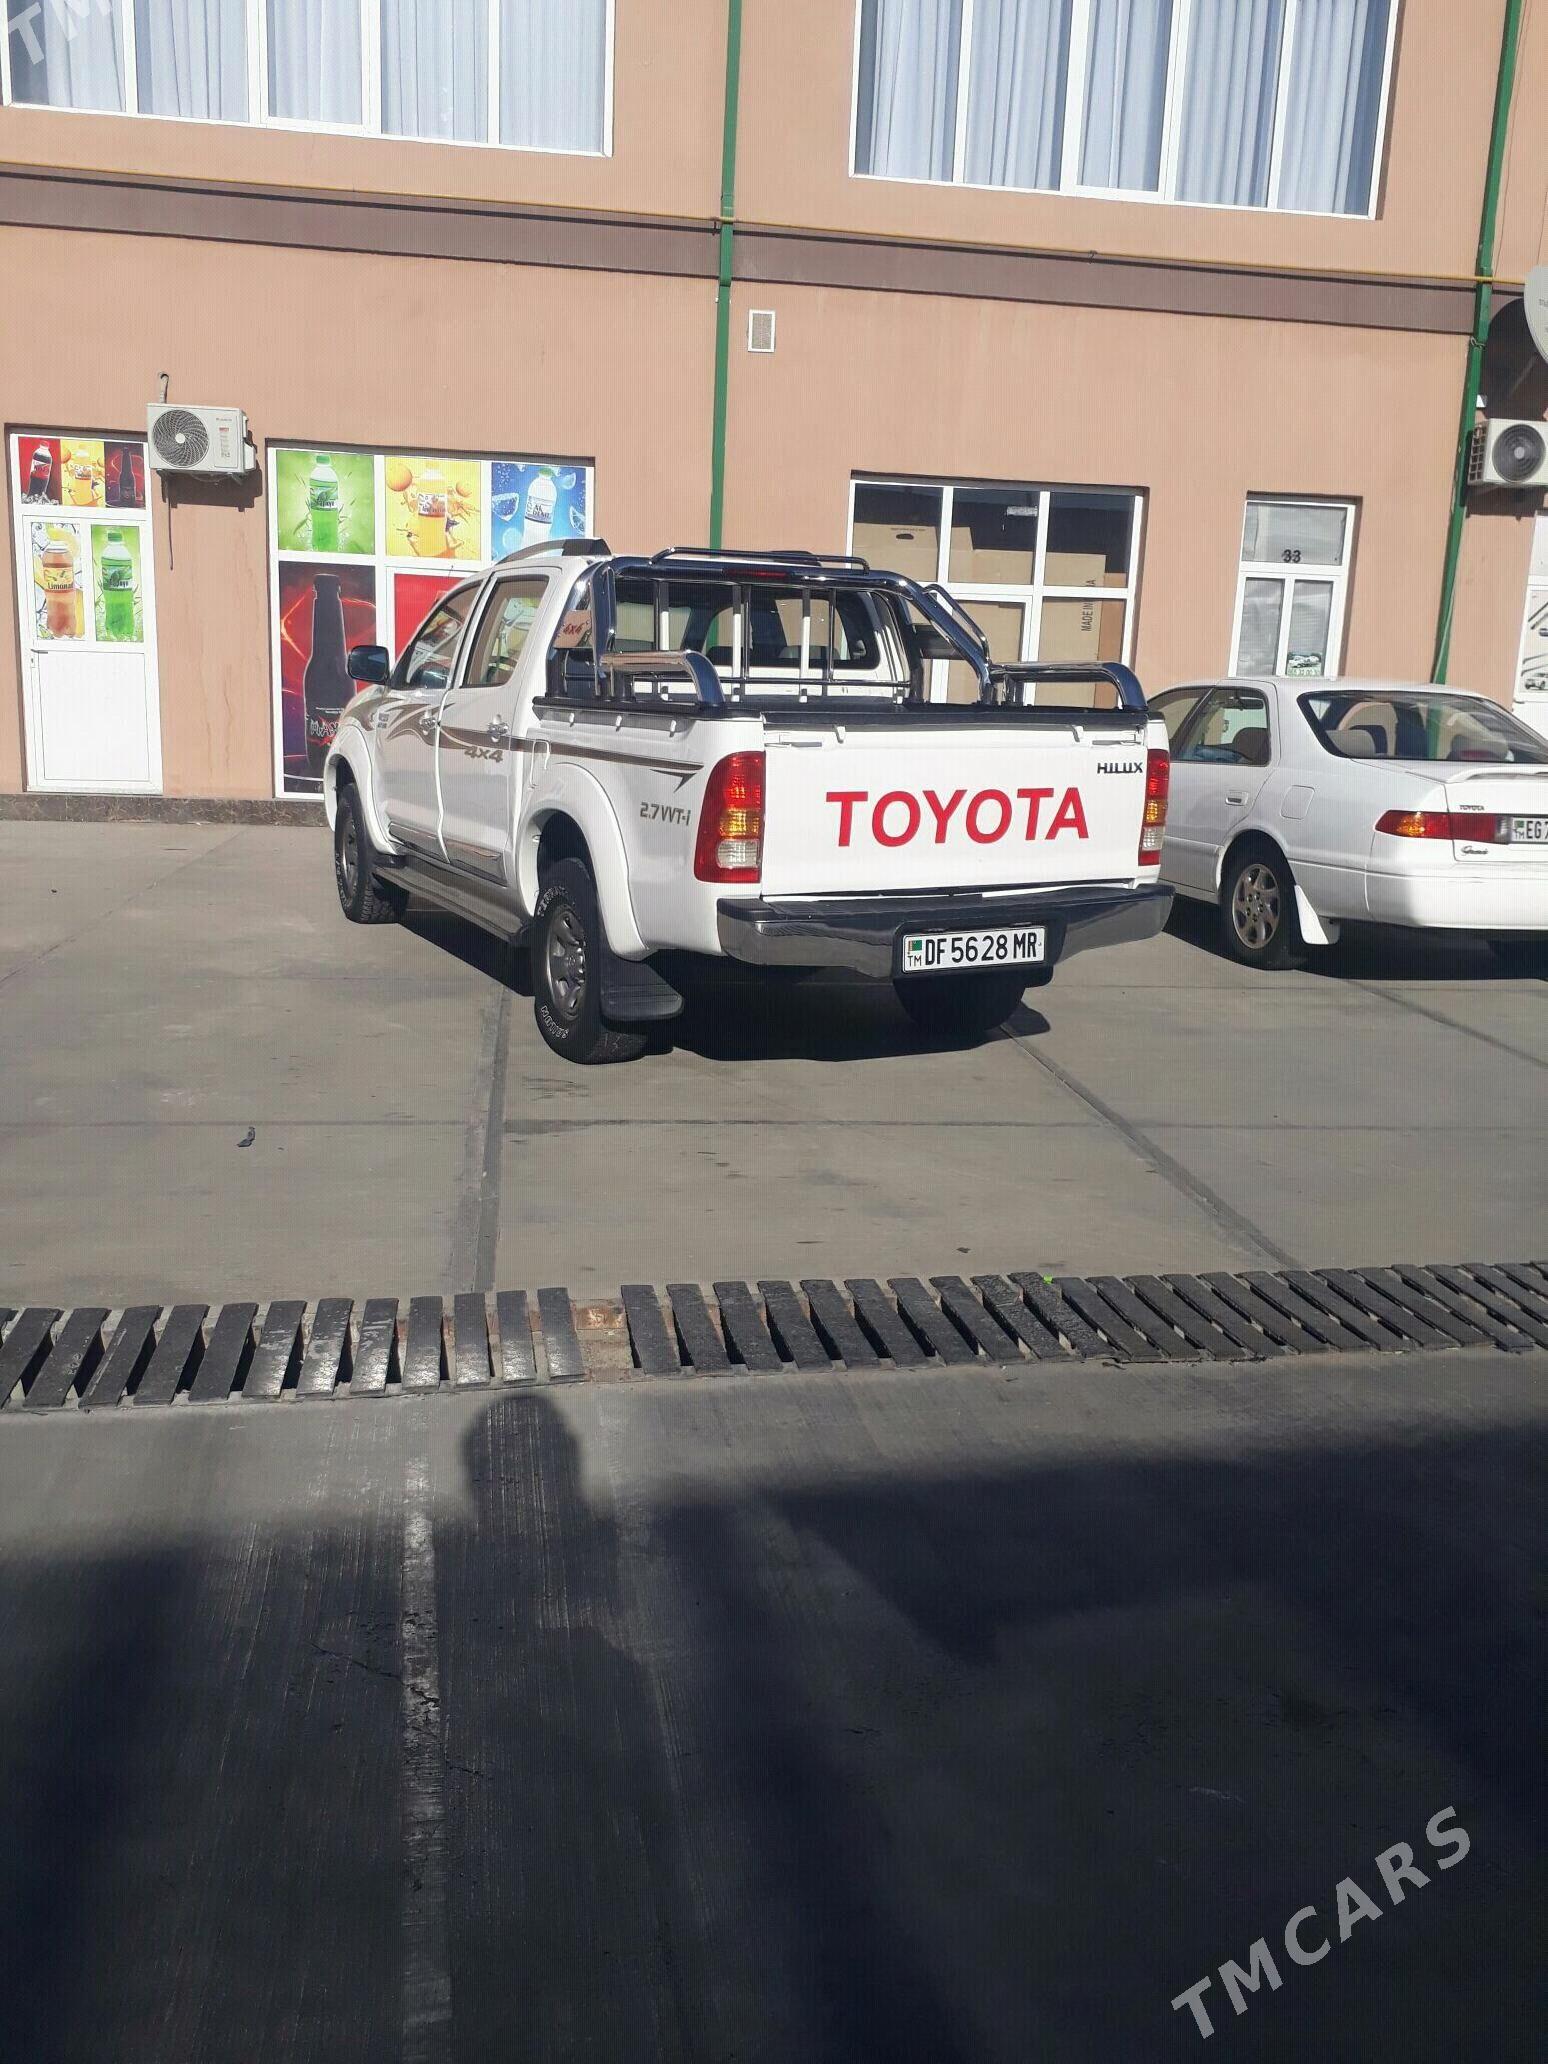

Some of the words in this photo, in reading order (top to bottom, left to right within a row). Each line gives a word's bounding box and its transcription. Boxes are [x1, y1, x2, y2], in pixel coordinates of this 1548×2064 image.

[1282, 549, 1301, 563] 33
[1081, 611, 1094, 632] MADE
[1097, 762, 1143, 774] HILUX
[826, 787, 1089, 847] TOYOTA
[951, 934, 1008, 963] 5628
[1013, 932, 1037, 959] MR
[908, 955, 922, 967] TM
